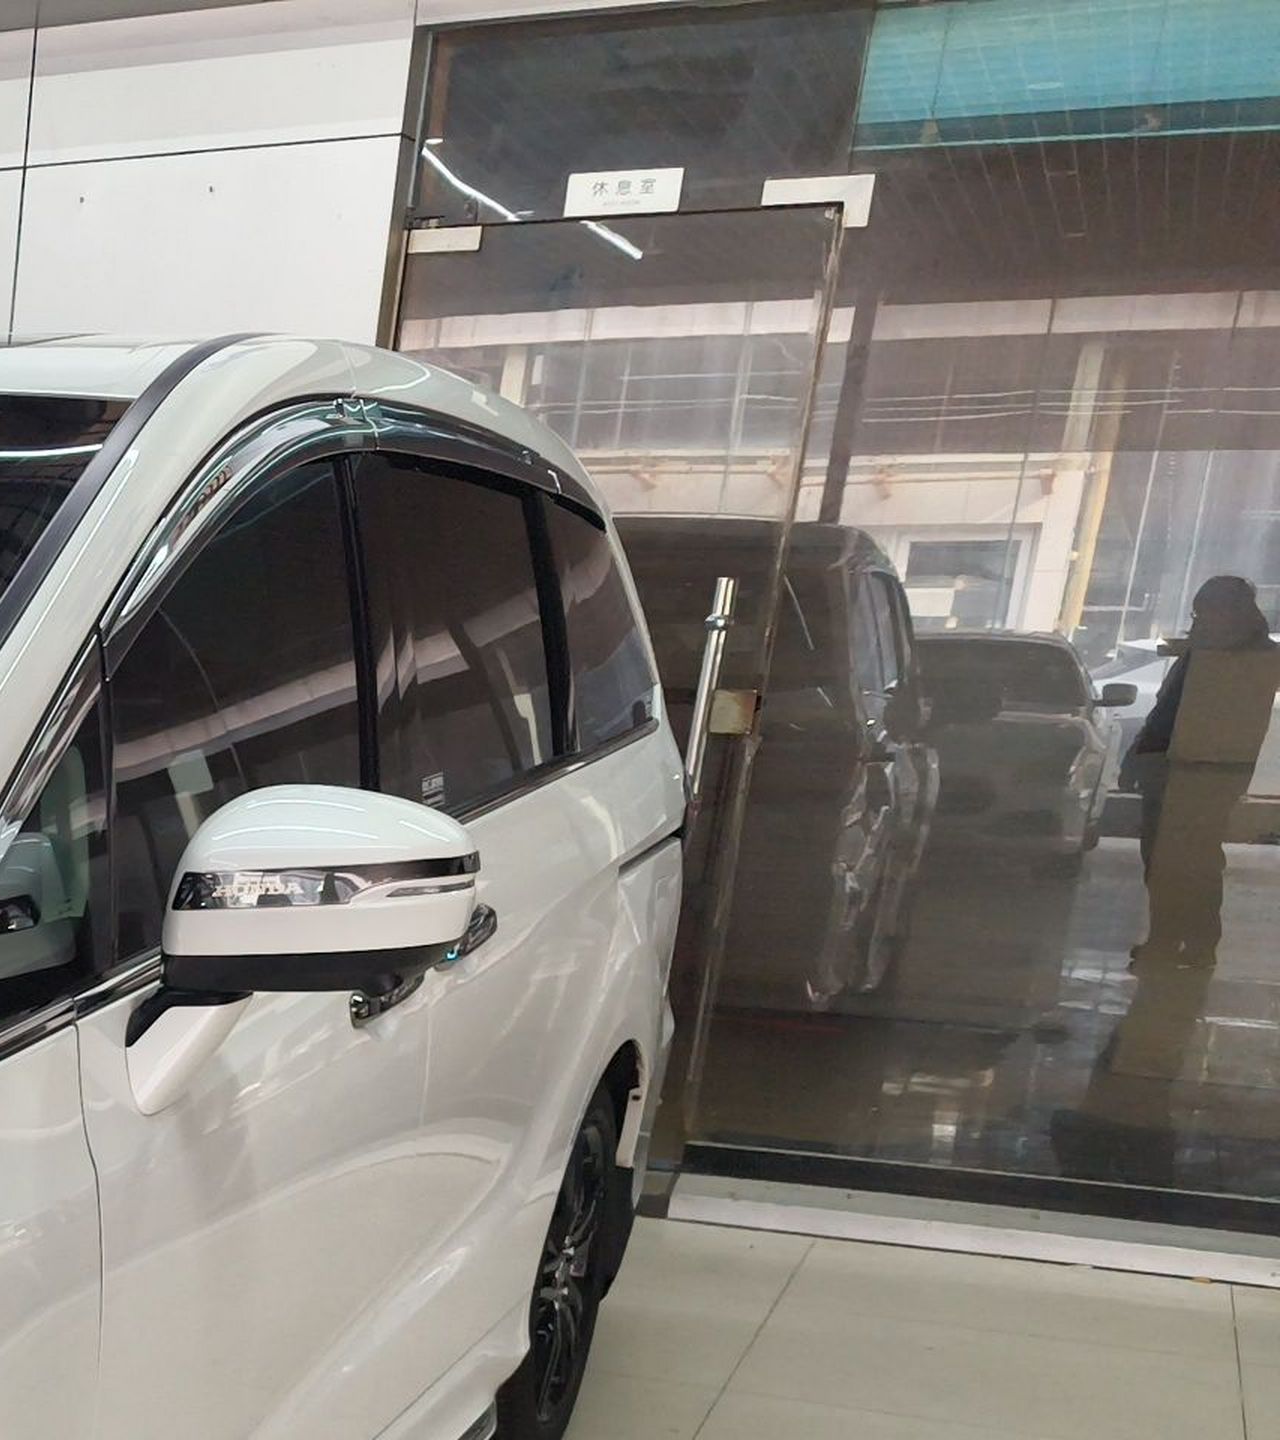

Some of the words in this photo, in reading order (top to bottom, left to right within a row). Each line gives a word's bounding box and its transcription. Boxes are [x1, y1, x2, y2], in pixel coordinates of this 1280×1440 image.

[592, 177, 656, 197] 休息室
[212, 882, 305, 898] HONDA
